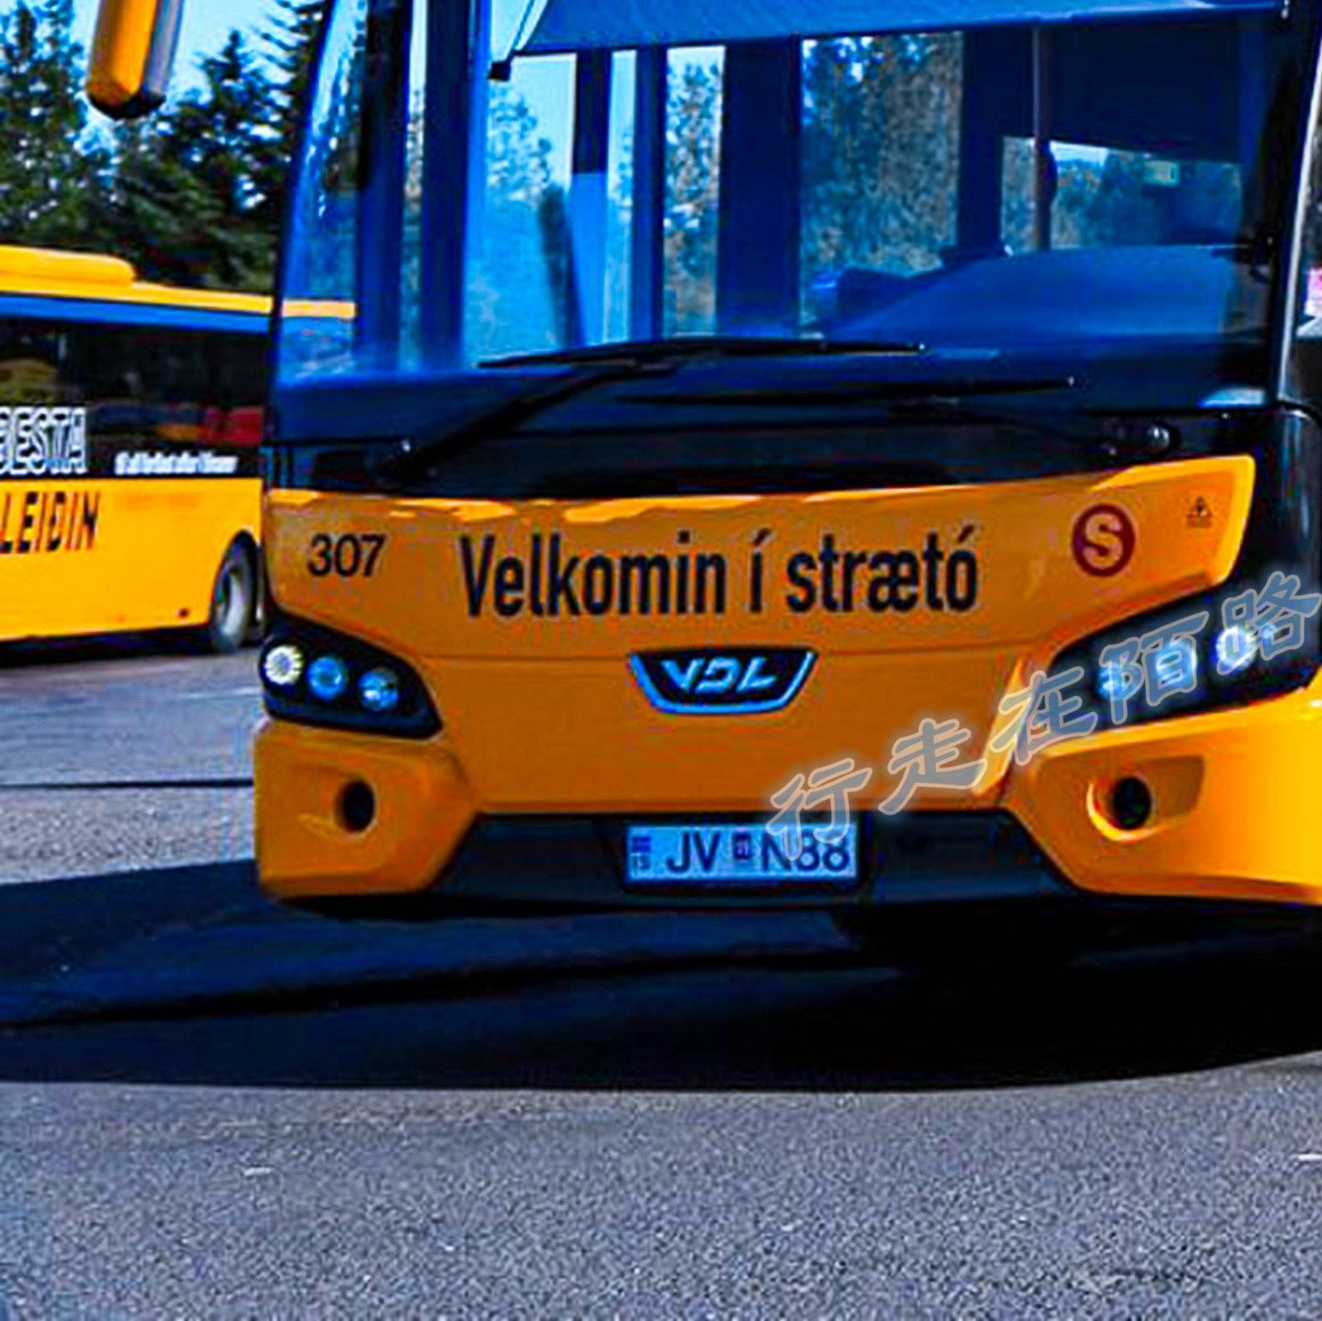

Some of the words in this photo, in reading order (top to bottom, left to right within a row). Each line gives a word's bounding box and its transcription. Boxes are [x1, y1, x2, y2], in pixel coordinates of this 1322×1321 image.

[307, 535, 385, 578] 307
[460, 529, 727, 618] Velkomin
[748, 528, 772, 613] í
[786, 524, 978, 614] strætó
[661, 657, 777, 694] VDL
[665, 832, 721, 873] JV
